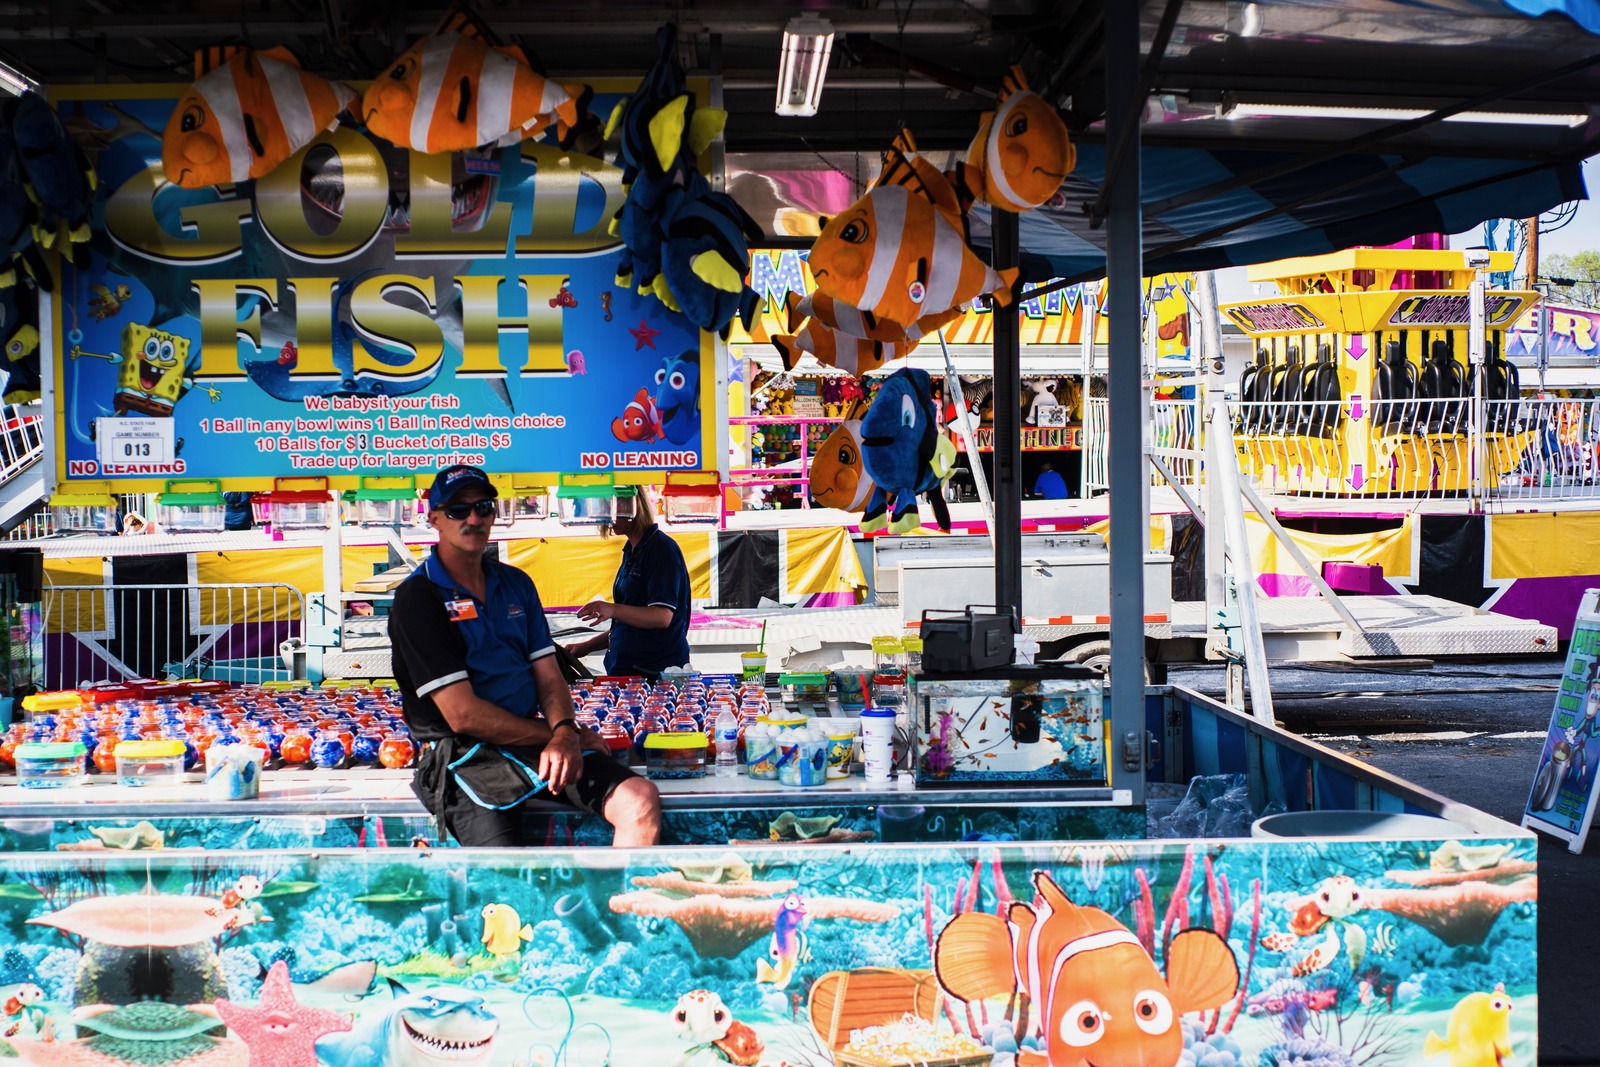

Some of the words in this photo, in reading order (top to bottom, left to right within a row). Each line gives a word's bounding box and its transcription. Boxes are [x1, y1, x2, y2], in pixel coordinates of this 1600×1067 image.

[105, 127, 626, 264] GOLD
[191, 275, 573, 383] FISH
[305, 397, 328, 410] We
[333, 396, 389, 412] babysit
[392, 398, 426, 411] your
[430, 395, 459, 408] fish
[201, 420, 208, 431] 1
[214, 419, 243, 432] Ball
[248, 419, 260, 431] in
[265, 420, 292, 434] any
[297, 417, 333, 431] bowl
[337, 417, 372, 430] wins
[376, 418, 383, 429] 1
[389, 416, 419, 429] Ball
[423, 416, 437, 428] in
[440, 416, 471, 429] Red
[474, 415, 510, 428] wins
[513, 414, 565, 427] choice
[124, 443, 150, 456] 013
[257, 439, 275, 451] 10
[279, 437, 317, 451] Balls
[320, 437, 342, 450] for
[374, 436, 427, 449] Bucket
[431, 435, 446, 448] of
[449, 434, 487, 448] Balls
[491, 434, 511, 448] $5
[71, 461, 97, 474] NO
[103, 460, 185, 474] LEANING
[291, 454, 335, 467] Trade
[339, 457, 359, 470] up
[362, 453, 383, 466] for
[387, 453, 433, 470] larger
[437, 453, 484, 469] prizes
[582, 453, 609, 467] NO
[614, 452, 696, 467] LEANING
